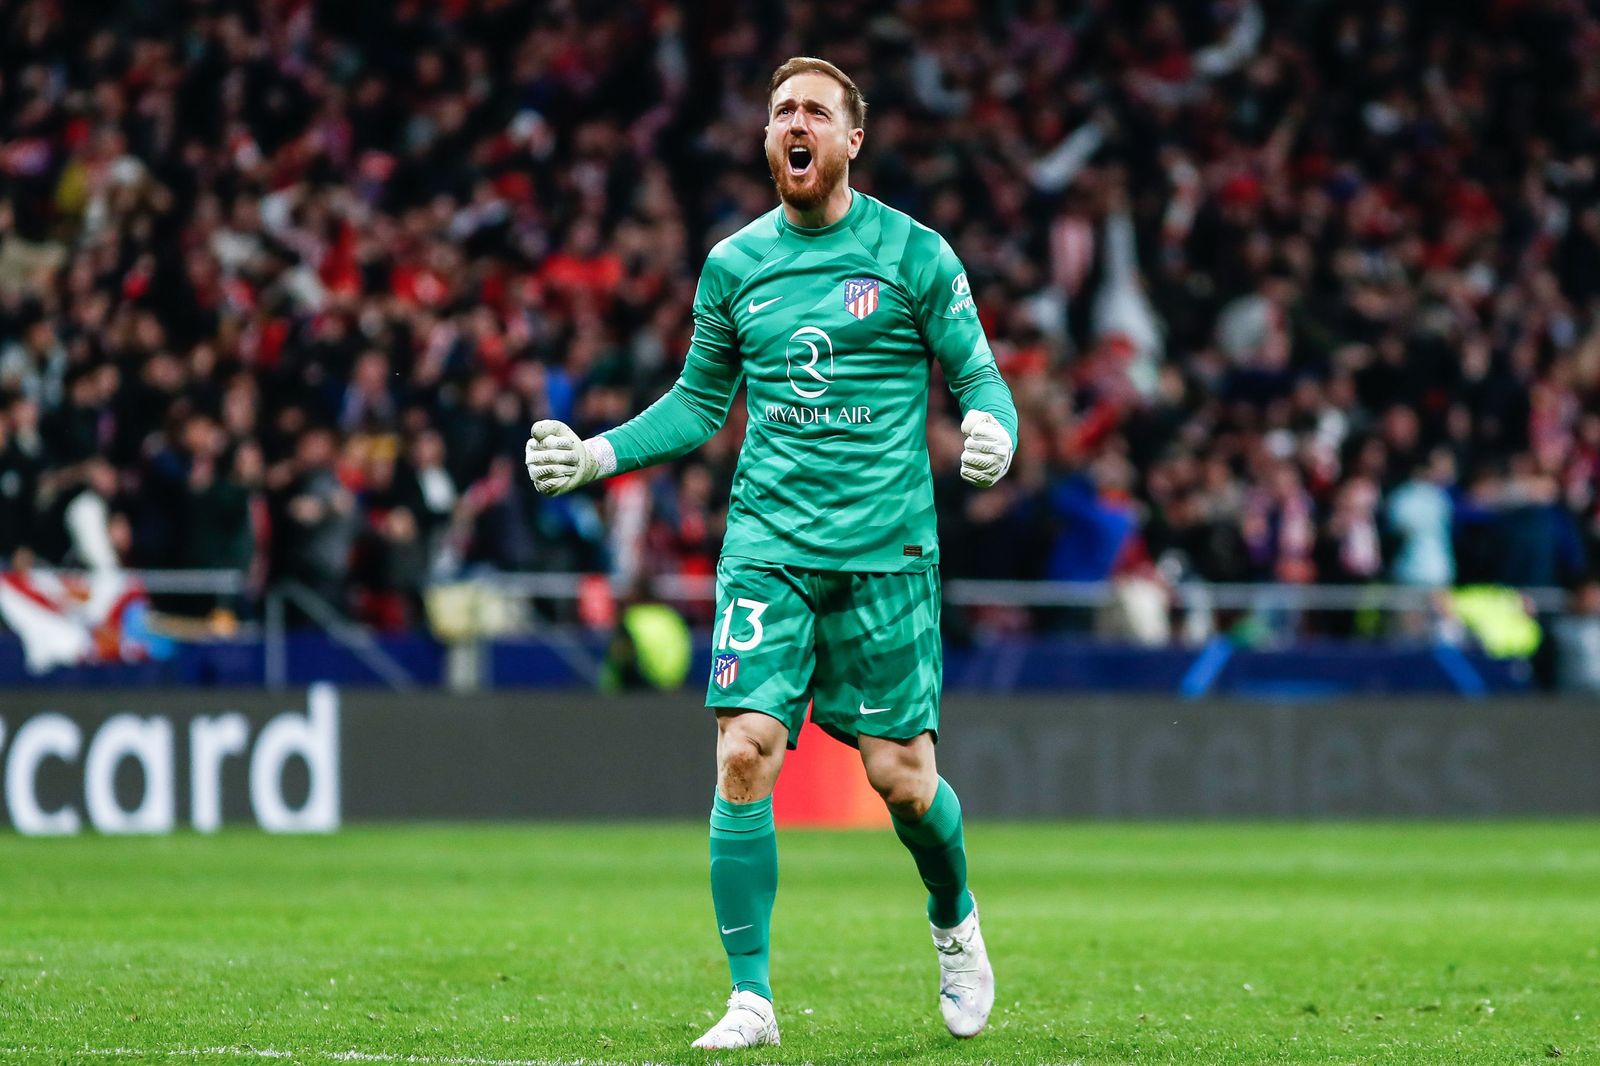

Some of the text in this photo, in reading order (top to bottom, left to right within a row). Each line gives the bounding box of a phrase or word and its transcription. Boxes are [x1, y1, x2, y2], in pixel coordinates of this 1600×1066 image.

[765, 405, 872, 424] RIYADH AIR
[718, 597, 769, 651] 13
[0, 680, 341, 836] card
